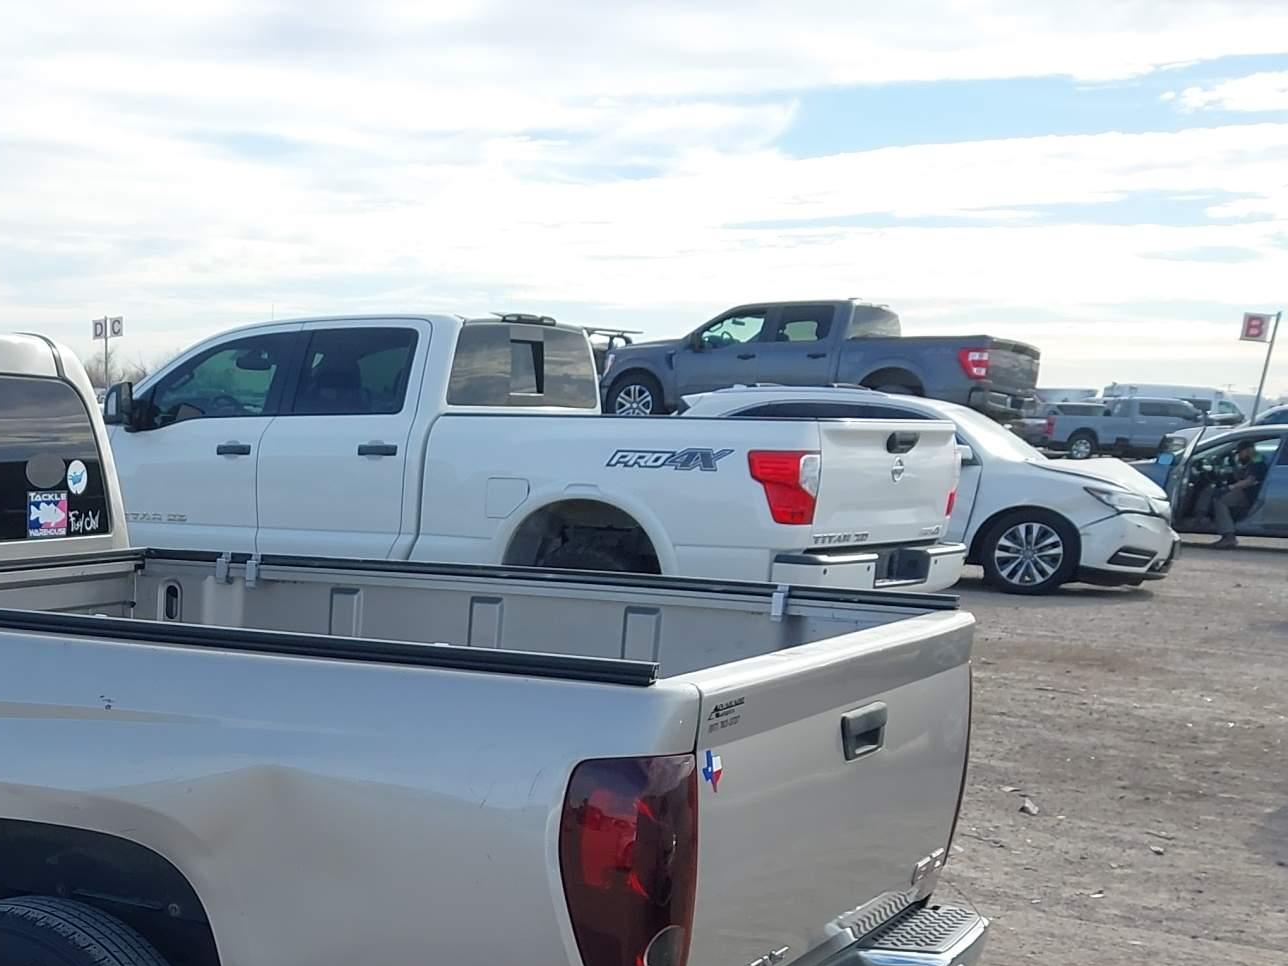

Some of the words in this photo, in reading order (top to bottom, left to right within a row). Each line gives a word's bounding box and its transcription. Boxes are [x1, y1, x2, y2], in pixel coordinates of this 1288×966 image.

[95, 321, 104, 337] D
[112, 319, 122, 335] C
[1245, 315, 1264, 337] B
[28, 492, 67, 501] TACKLE
